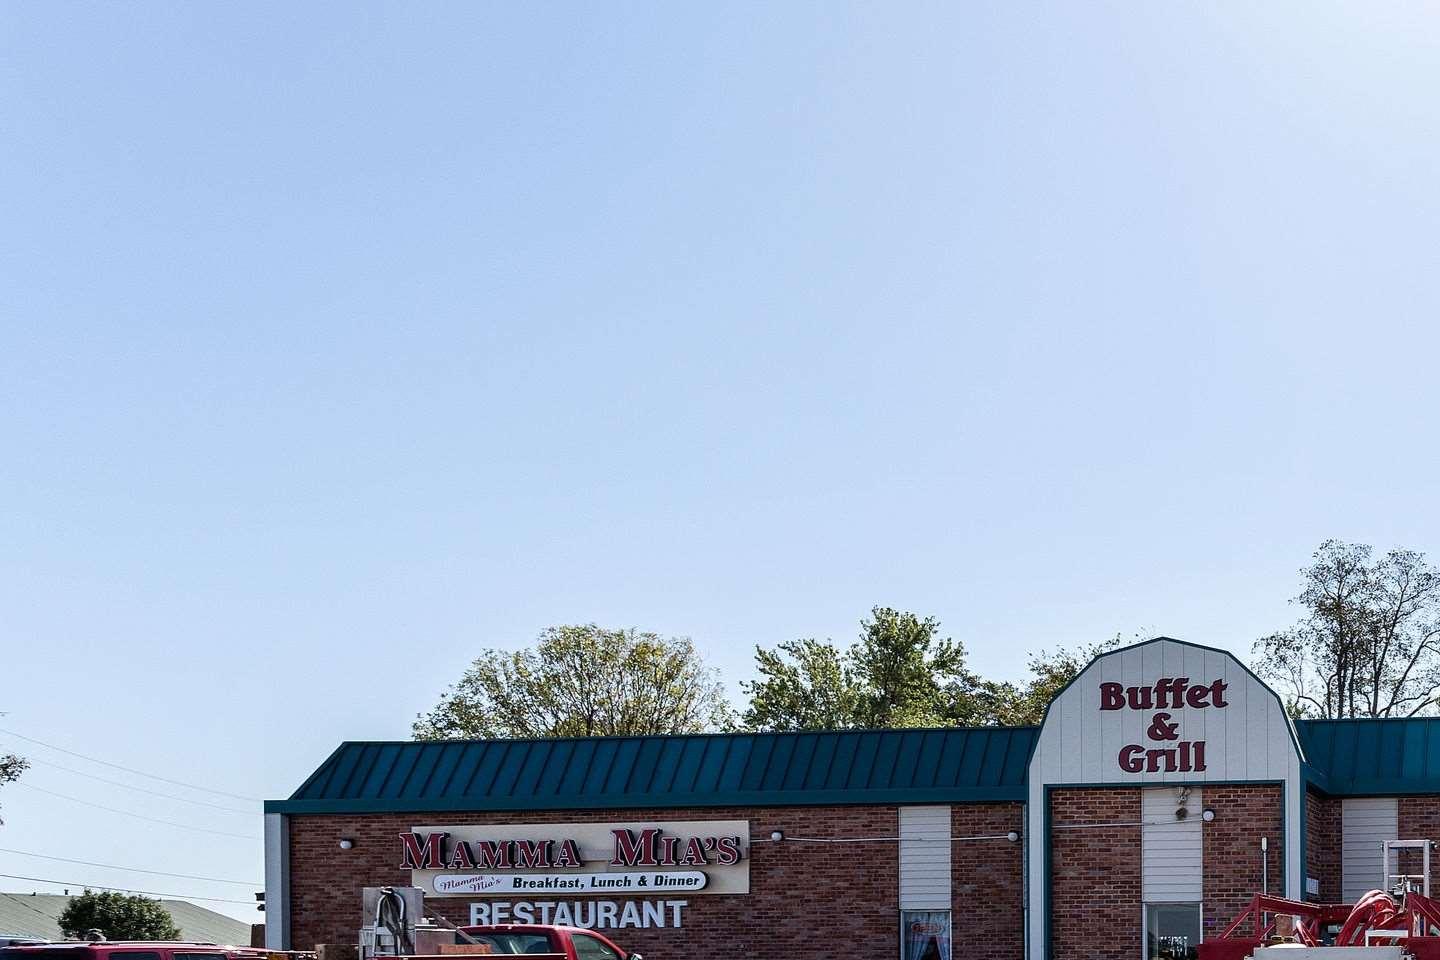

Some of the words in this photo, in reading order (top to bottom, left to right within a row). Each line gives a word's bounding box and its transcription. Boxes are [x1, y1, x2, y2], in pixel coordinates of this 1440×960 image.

[1099, 677, 1229, 711] Buffet
[1147, 712, 1180, 742] &
[1118, 741, 1207, 774] Grill
[399, 831, 585, 870] MAMMA
[609, 828, 742, 867] MIA'S
[440, 875, 484, 891] Mamma
[470, 876, 503, 892] Mia's
[512, 876, 586, 890] Breakfast,
[590, 874, 632, 888] Lunch
[637, 875, 648, 887] &
[653, 874, 701, 888] Dinner
[469, 900, 689, 929] RESTAURANT
